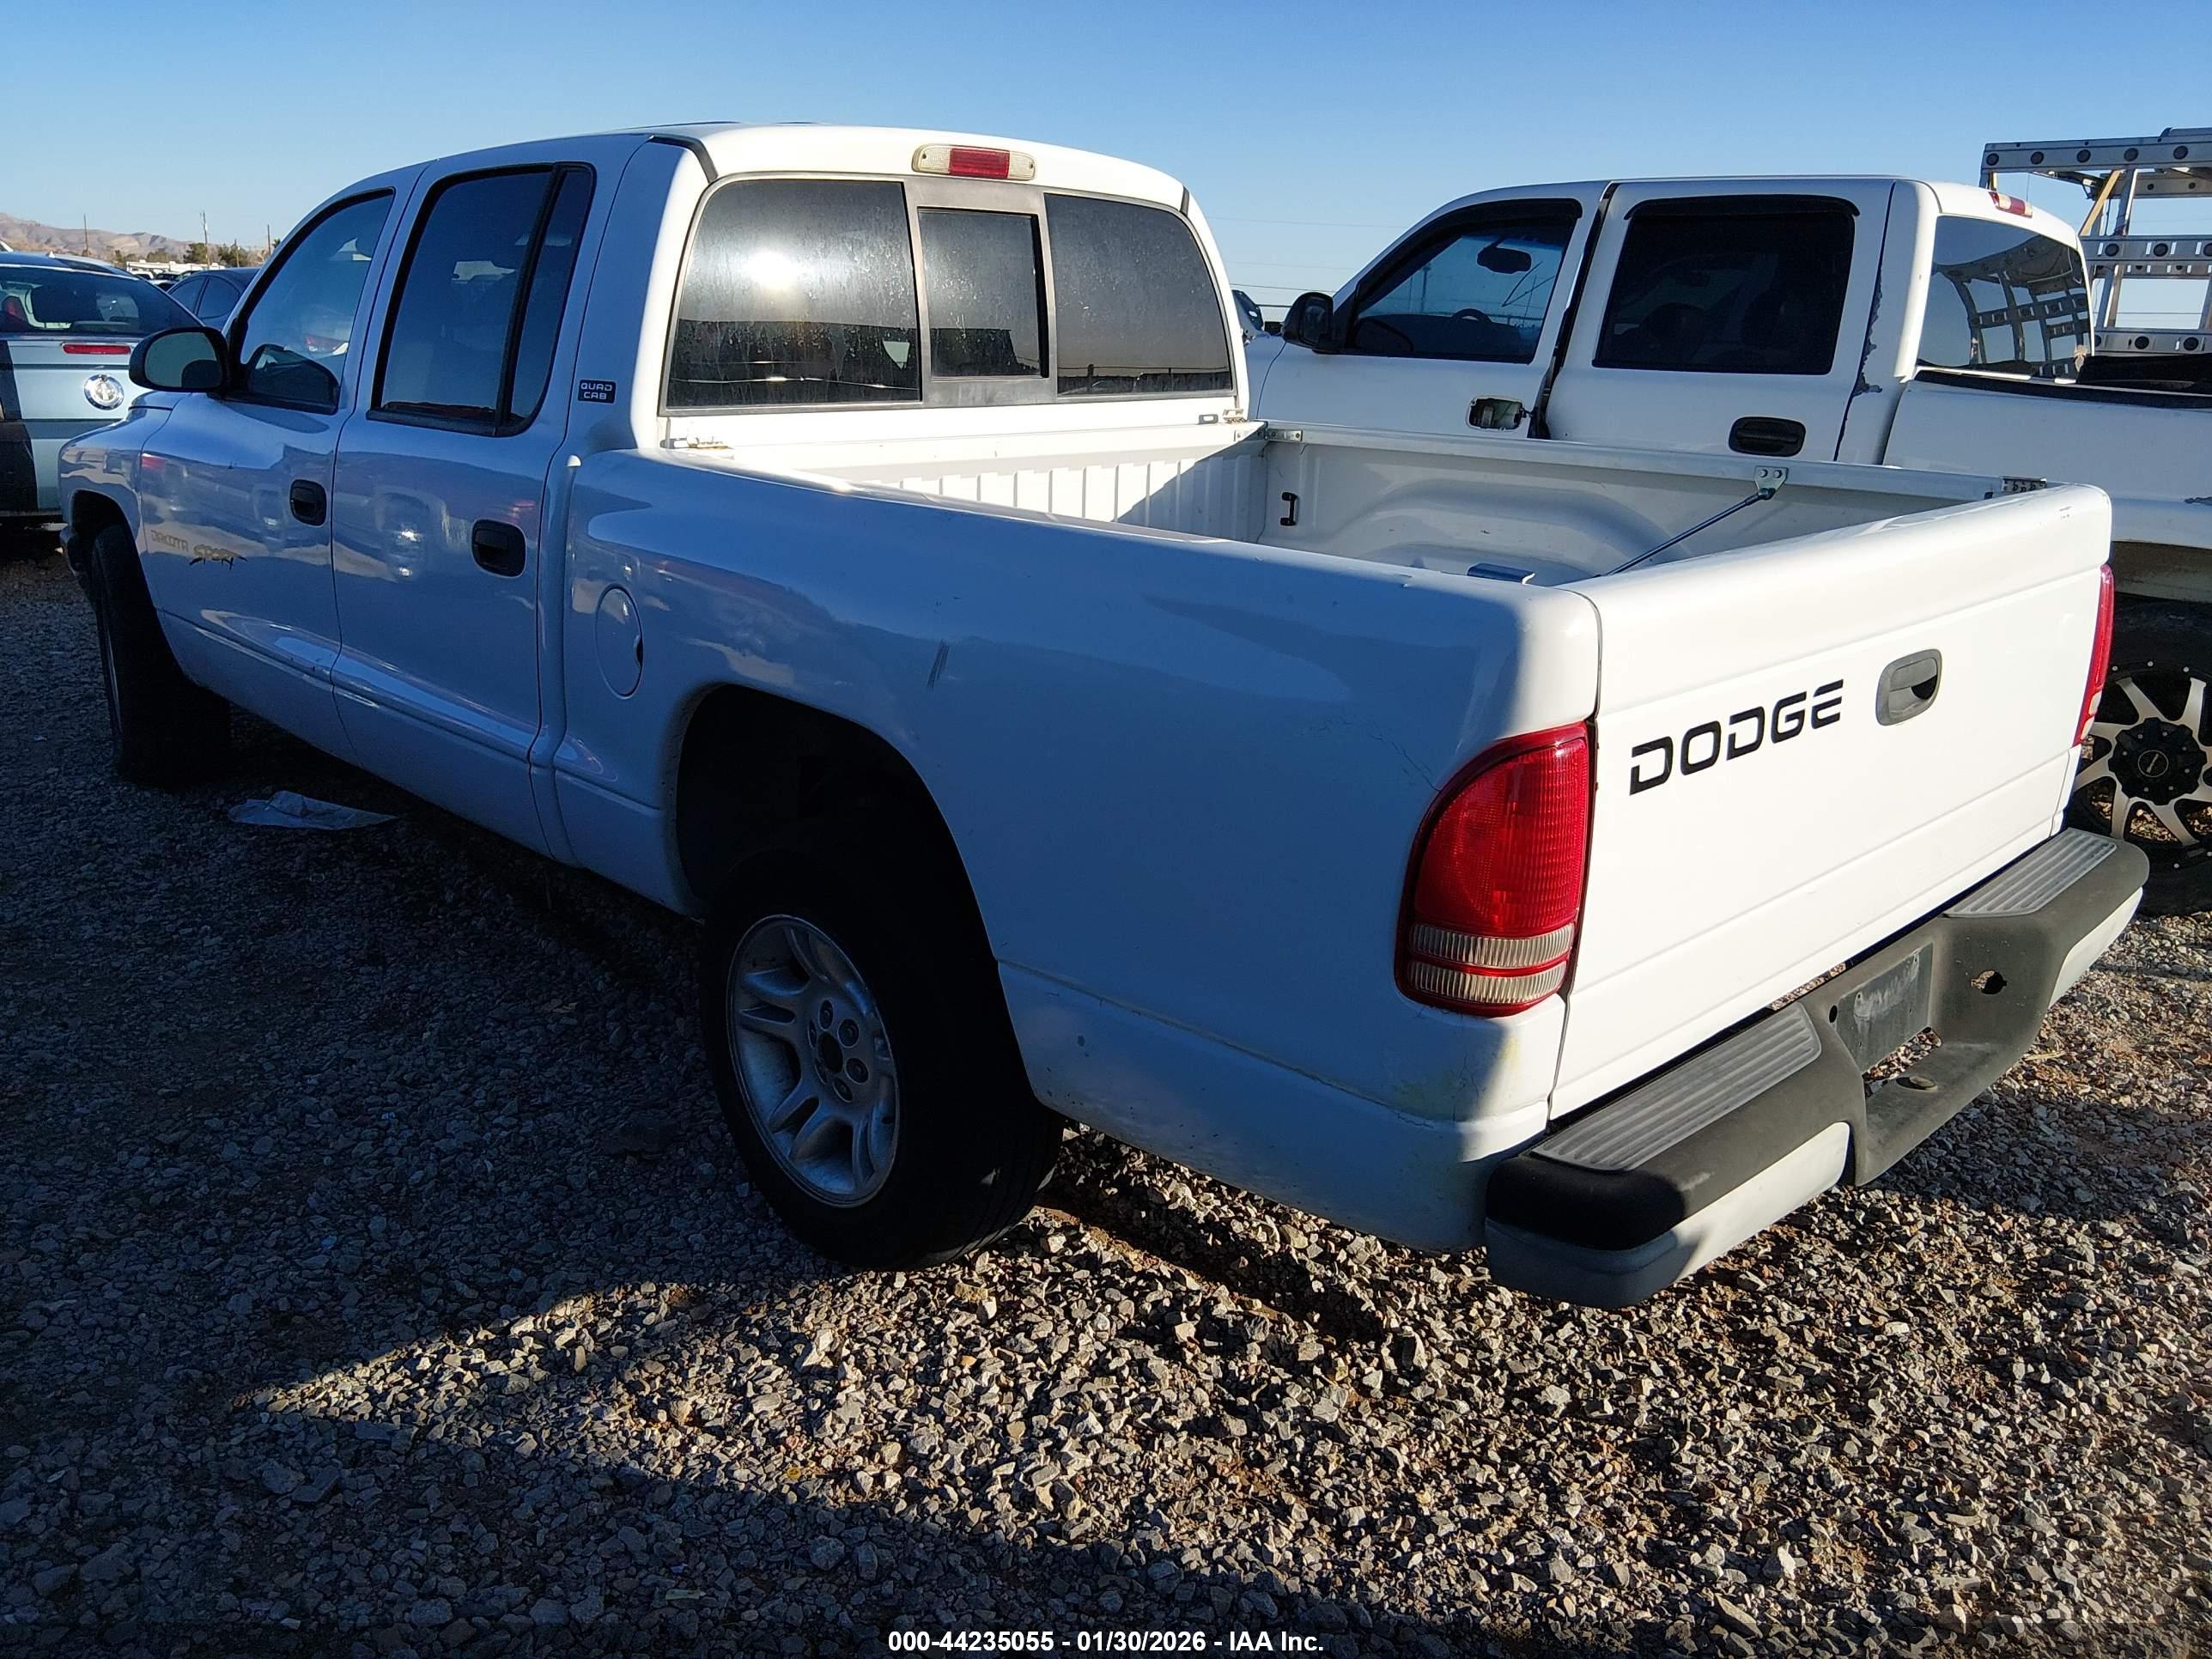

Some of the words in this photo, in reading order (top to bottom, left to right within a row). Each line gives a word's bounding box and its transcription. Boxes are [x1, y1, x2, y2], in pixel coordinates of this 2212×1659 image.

[580, 382, 613, 392] QUAD
[583, 391, 607, 400] CAB
[1629, 678, 1844, 795] DODGE
